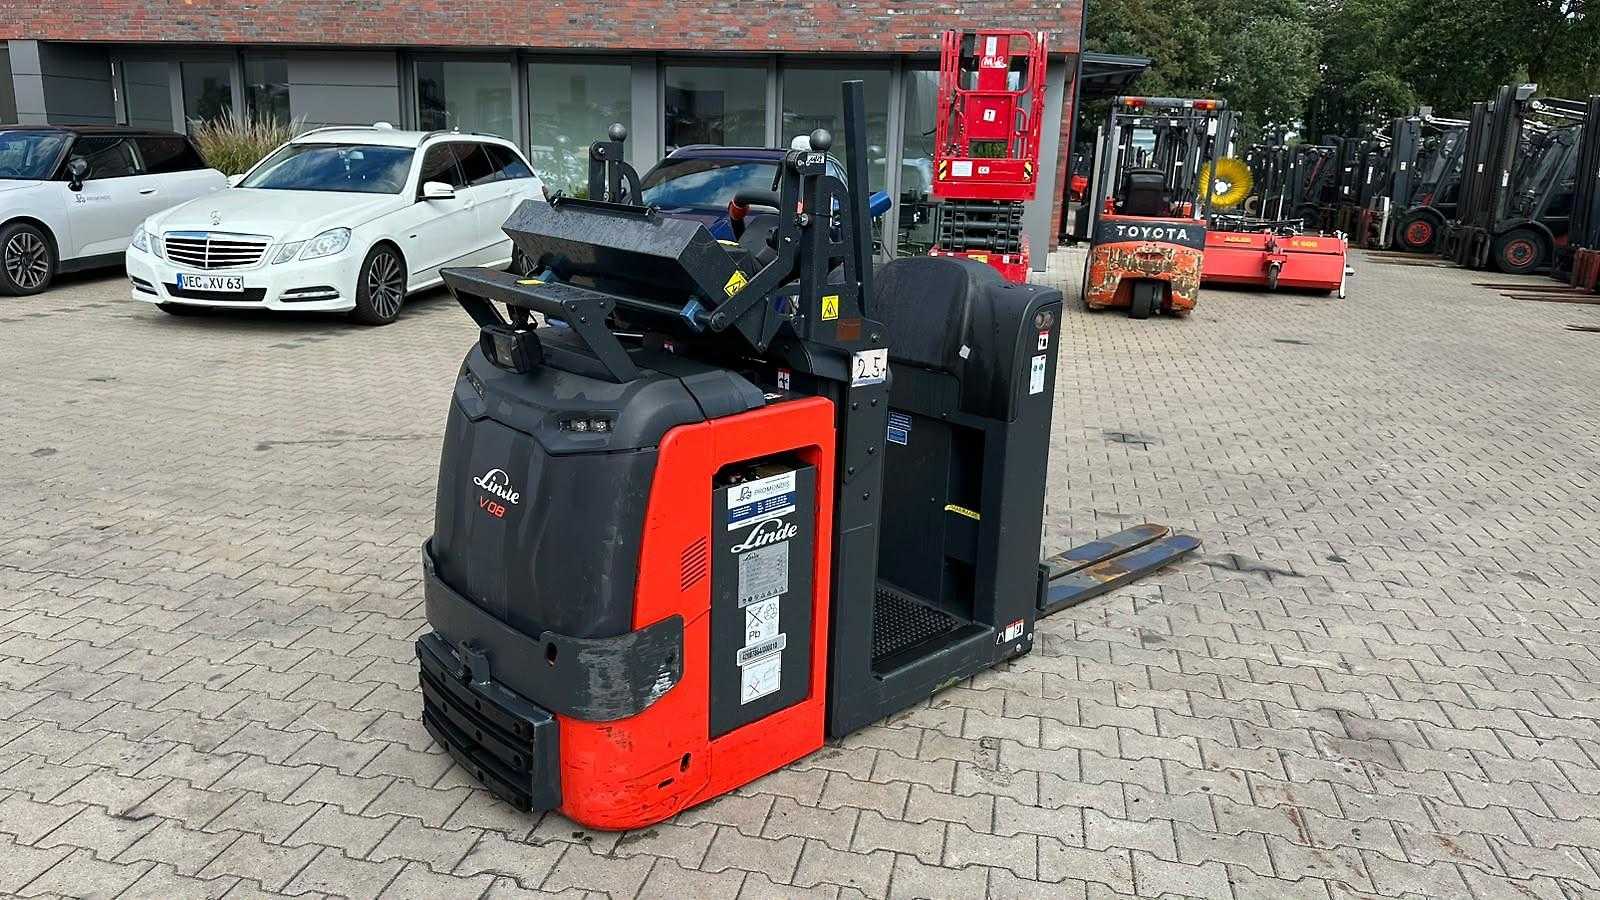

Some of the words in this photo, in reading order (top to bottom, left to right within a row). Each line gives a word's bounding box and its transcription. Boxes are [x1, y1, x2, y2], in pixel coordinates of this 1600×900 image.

[1116, 225, 1187, 240] TOYOTA
[183, 275, 202, 288] VEC
[209, 277, 223, 289] XV
[226, 277, 241, 289] 63
[473, 469, 520, 504] Linde
[731, 518, 797, 553] Linde
[749, 630, 761, 641] Pb
